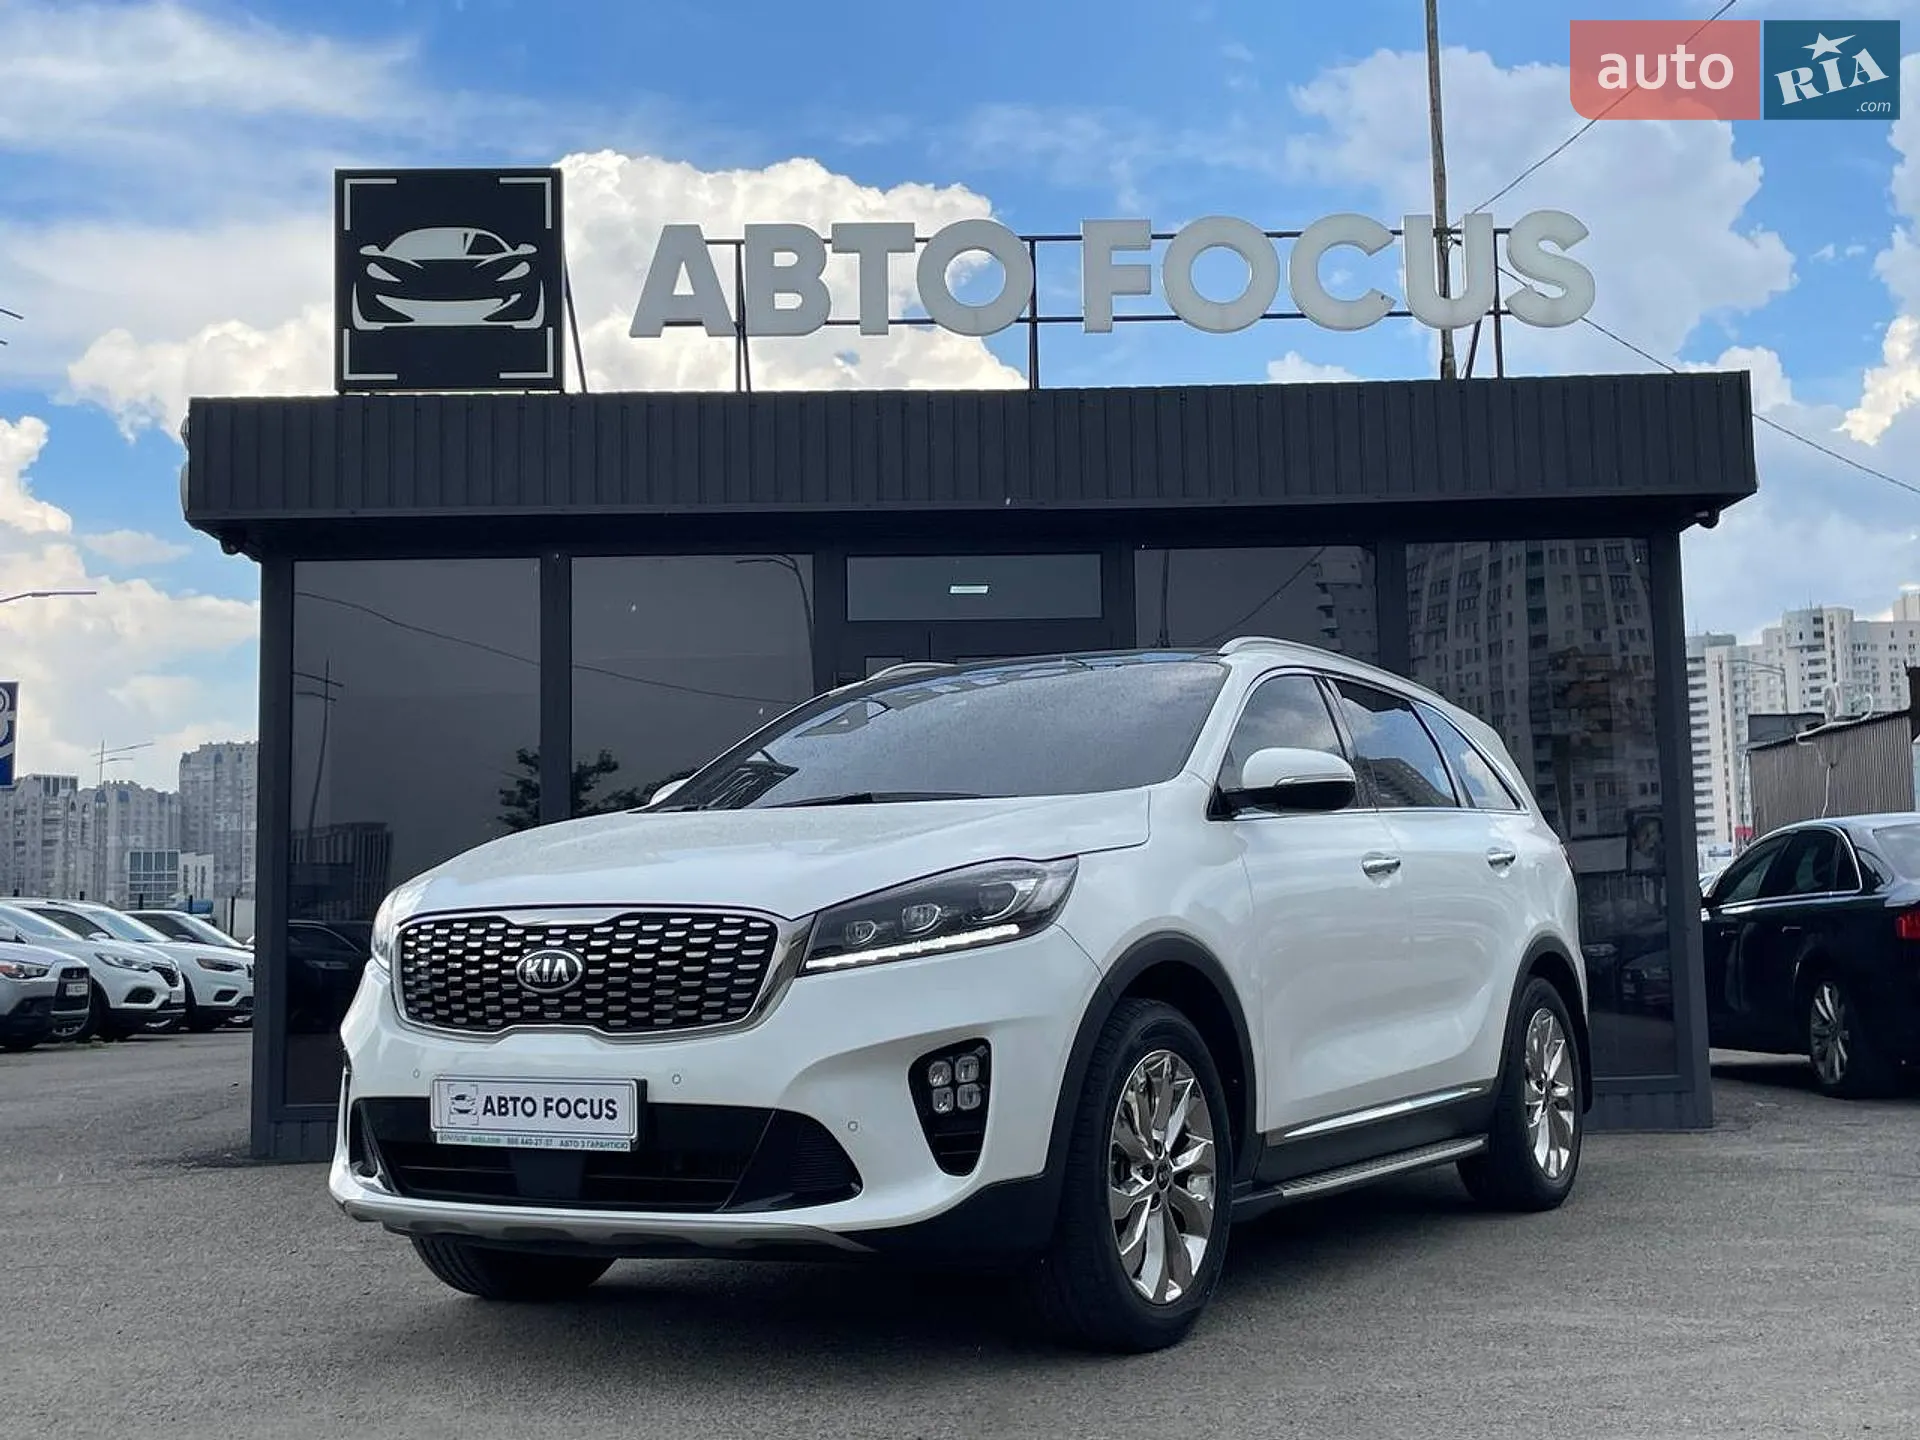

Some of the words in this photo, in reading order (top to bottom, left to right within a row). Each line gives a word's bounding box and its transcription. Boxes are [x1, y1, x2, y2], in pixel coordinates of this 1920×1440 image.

[629, 219, 1034, 337] АВТО
[1082, 210, 1596, 334] FOCUS
[525, 958, 570, 983] KIA
[482, 1095, 537, 1118] АВТО
[543, 1096, 618, 1120] FOCUS
